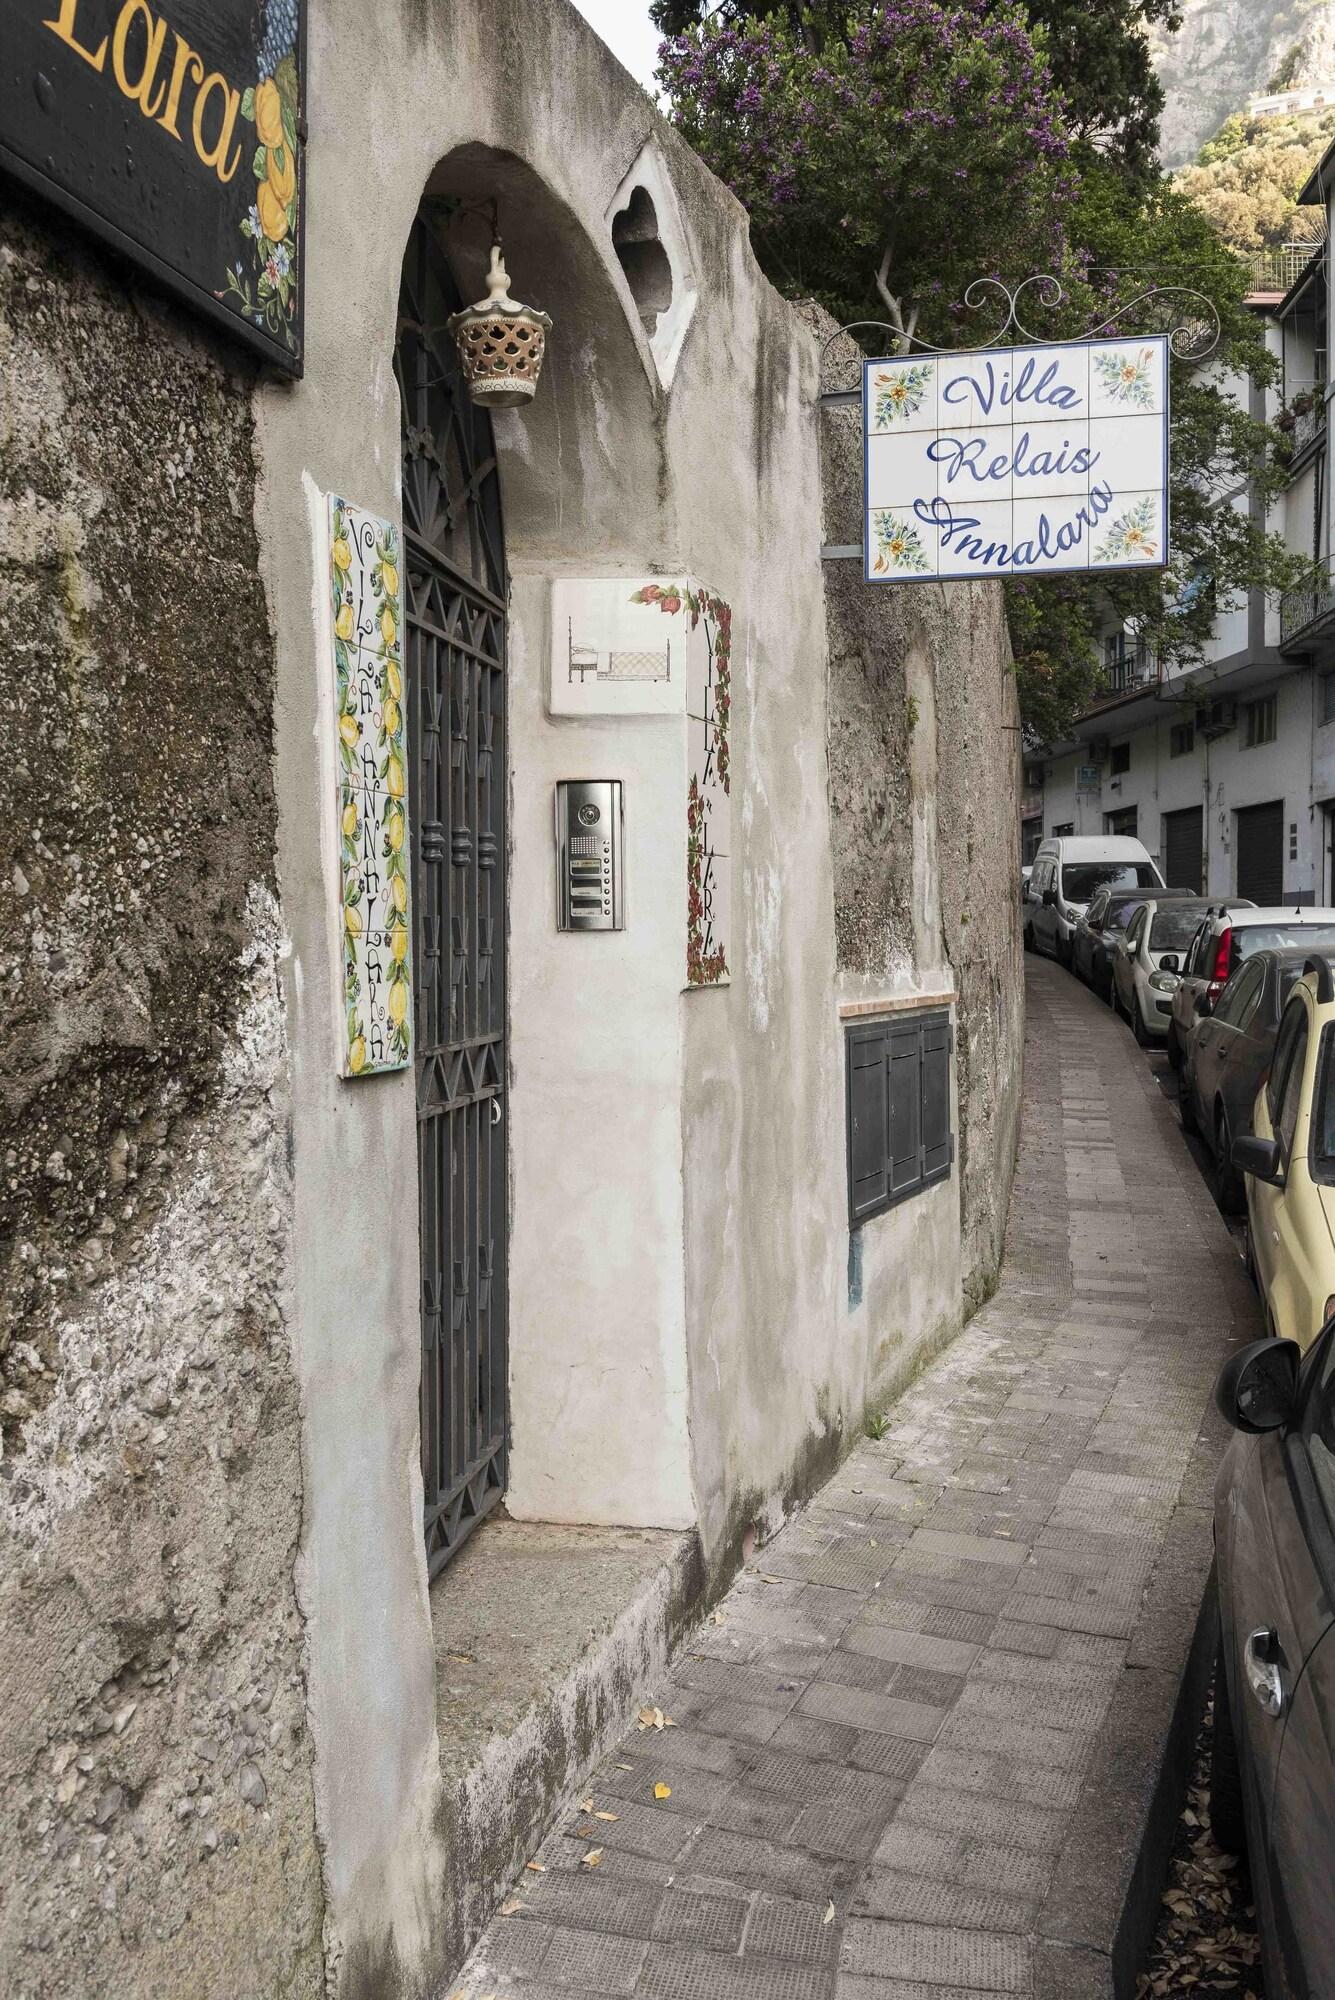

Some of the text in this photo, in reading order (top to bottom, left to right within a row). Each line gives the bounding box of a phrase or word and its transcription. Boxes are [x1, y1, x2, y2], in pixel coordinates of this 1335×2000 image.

[942, 357, 1083, 415] Villa
[926, 432, 1101, 483] Relais
[913, 480, 1114, 566] Annalara
[349, 518, 376, 715] VILLA
[702, 618, 717, 955] VILLA LARA
